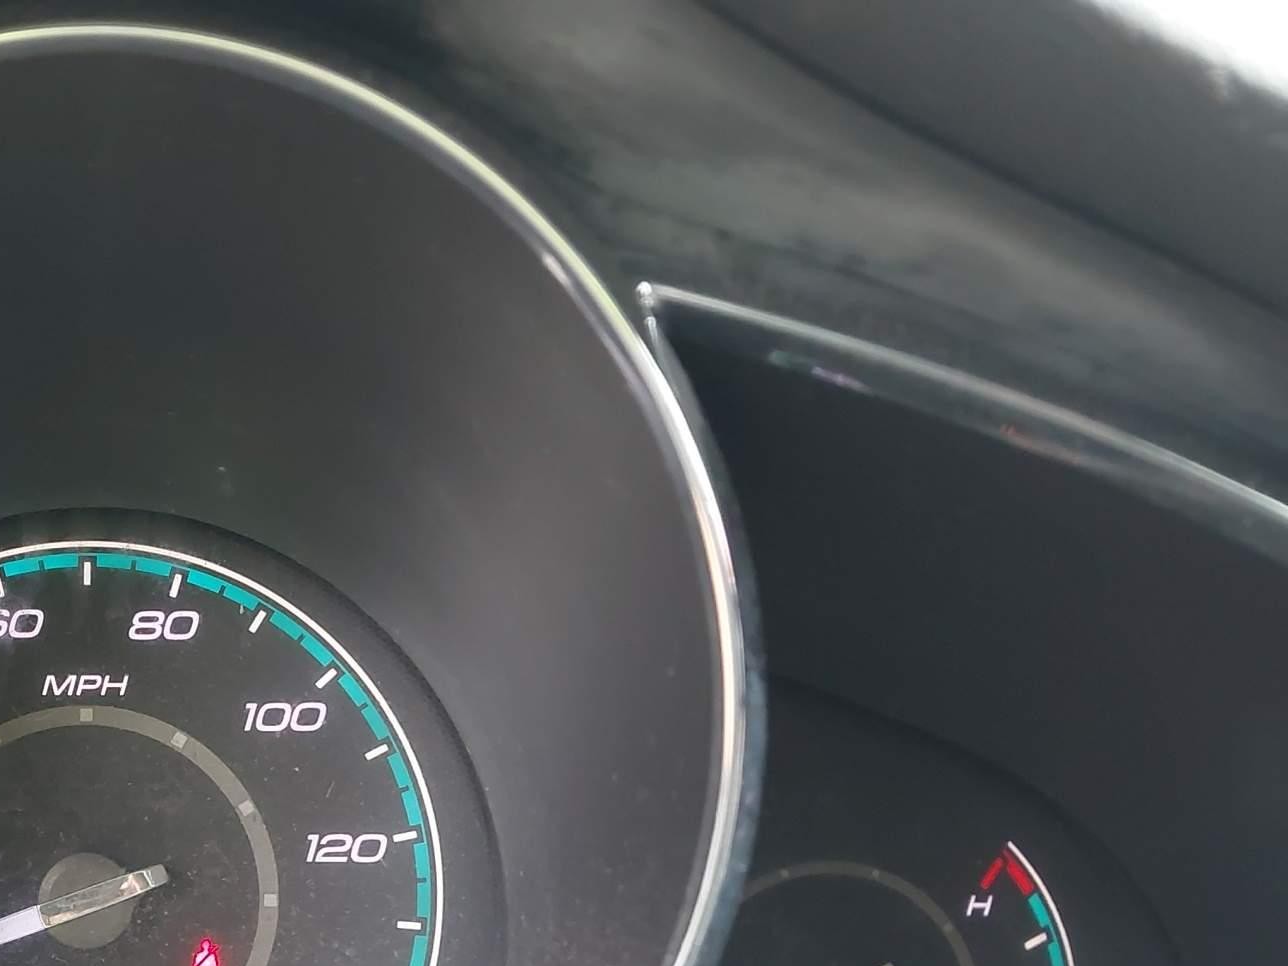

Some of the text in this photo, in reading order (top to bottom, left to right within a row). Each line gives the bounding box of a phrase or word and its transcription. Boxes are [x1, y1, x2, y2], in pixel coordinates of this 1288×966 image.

[128, 610, 200, 641] 80
[42, 674, 129, 697] MPH
[244, 701, 327, 732] 100
[306, 833, 388, 863] 120
[966, 895, 993, 917] H
